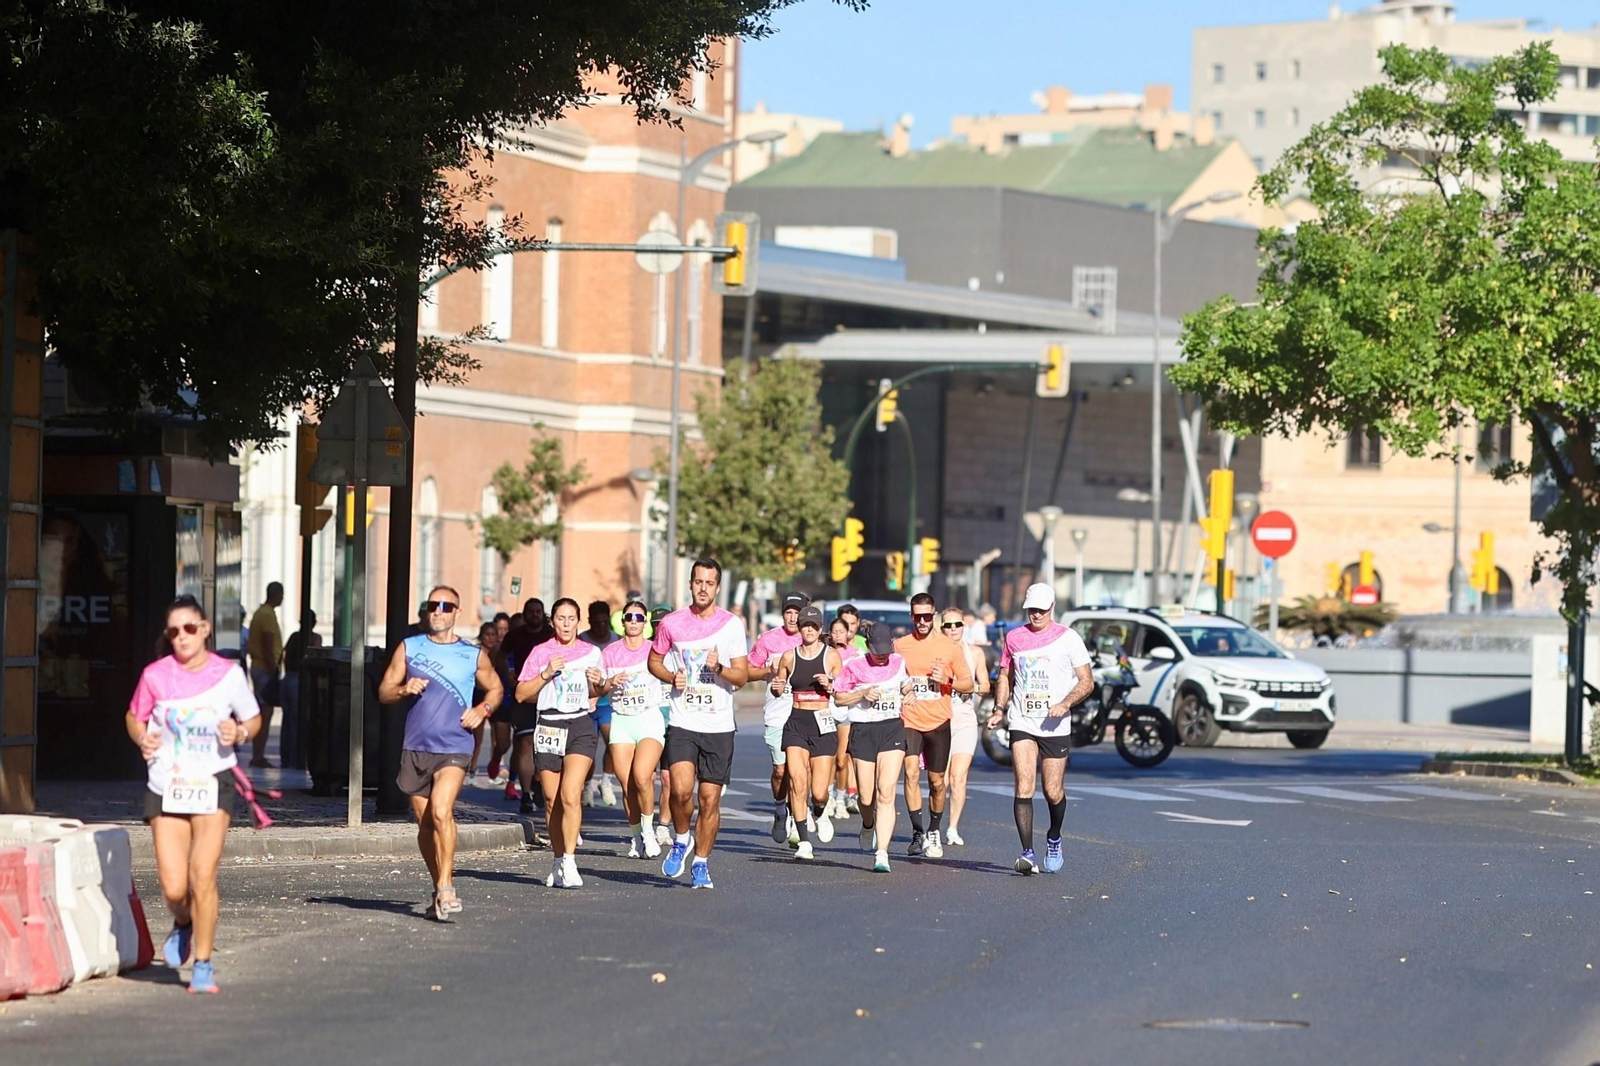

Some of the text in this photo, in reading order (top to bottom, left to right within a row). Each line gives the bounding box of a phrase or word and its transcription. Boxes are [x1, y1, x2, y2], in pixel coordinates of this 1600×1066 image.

[623, 696, 645, 705] 516
[687, 694, 712, 704] 213
[872, 701, 895, 711] 464
[1026, 701, 1050, 709] 661
[538, 735, 560, 747] 341
[172, 788, 208, 800] 670
